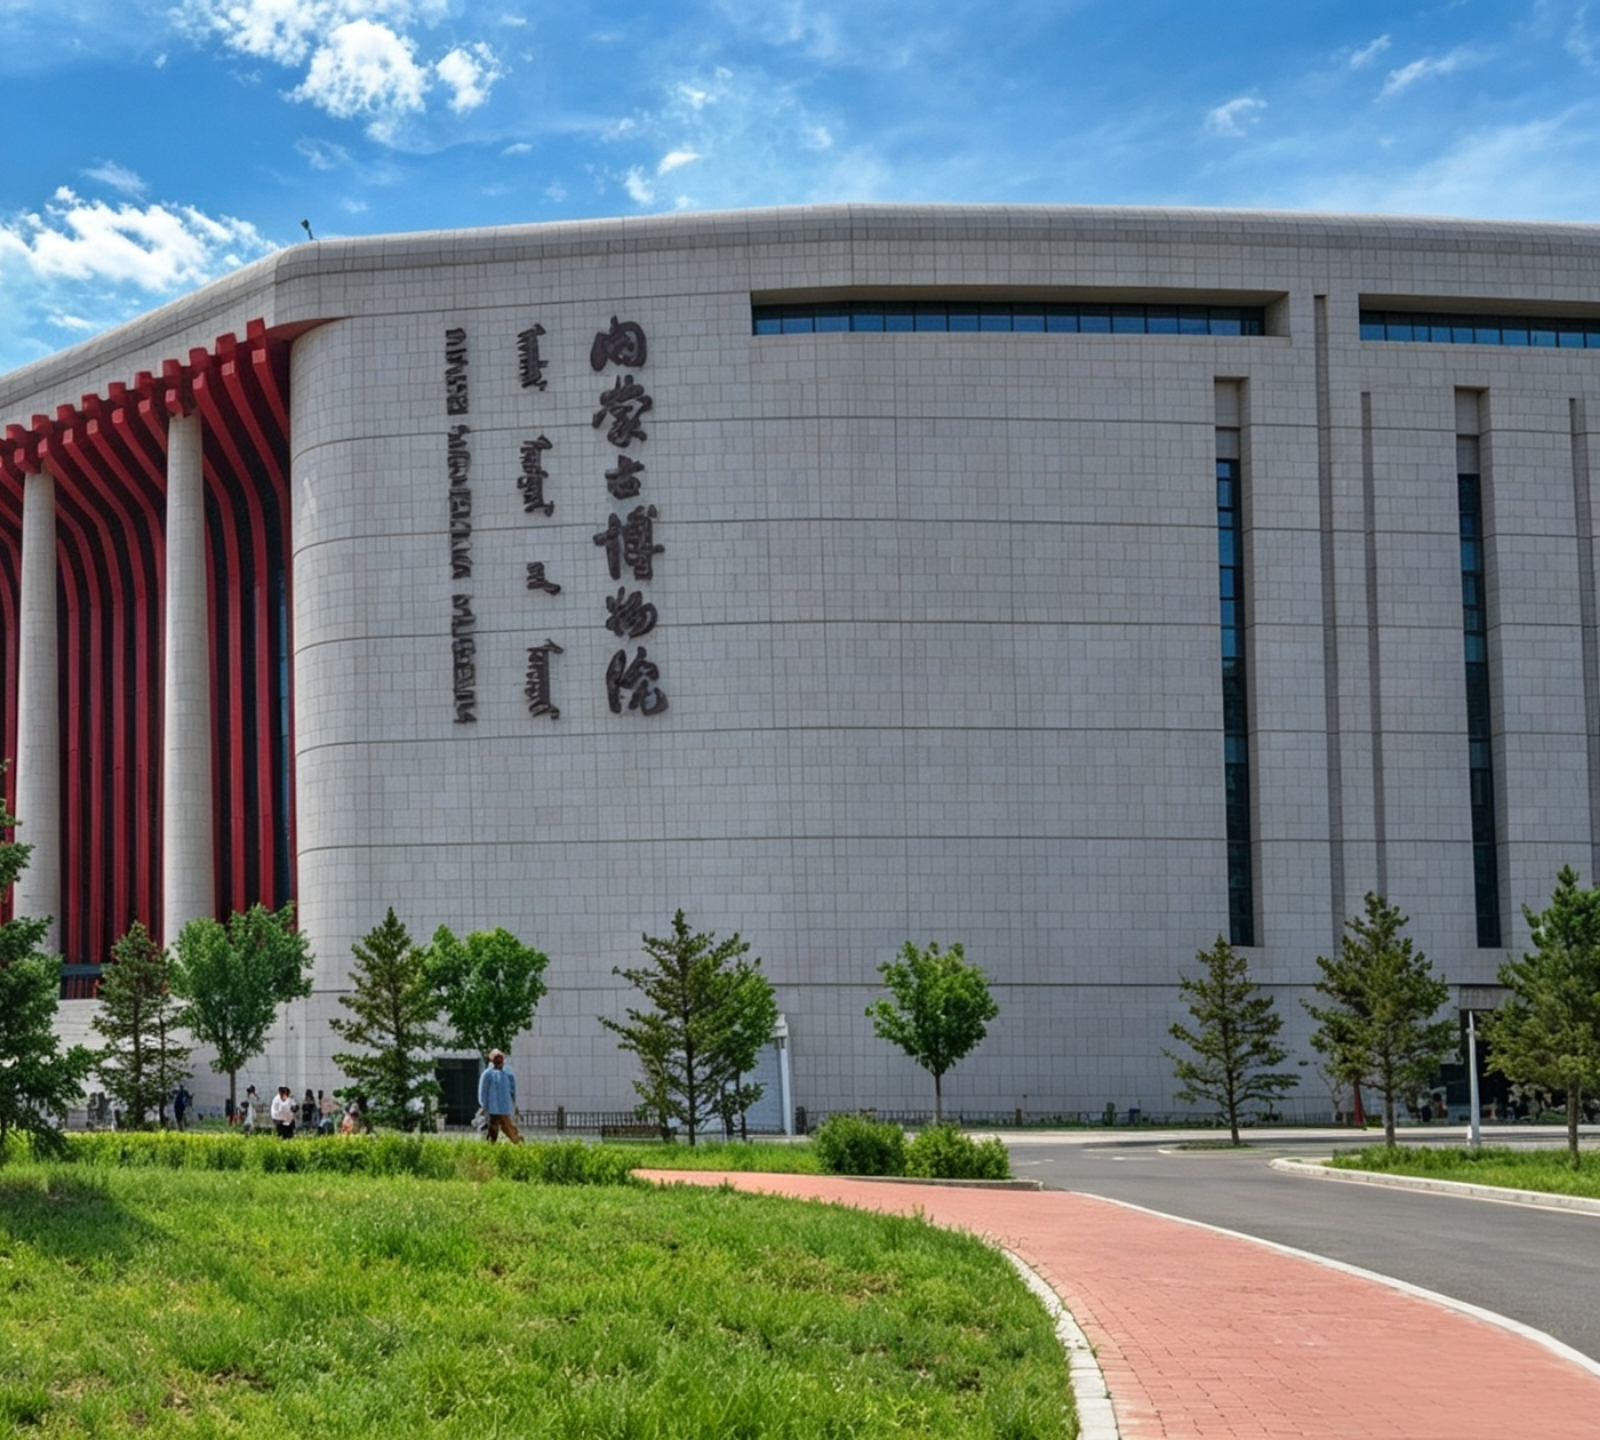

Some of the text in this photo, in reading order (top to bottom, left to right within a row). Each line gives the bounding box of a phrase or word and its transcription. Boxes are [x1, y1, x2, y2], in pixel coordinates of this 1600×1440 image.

[589, 315, 669, 717] 内蒙古博物院
